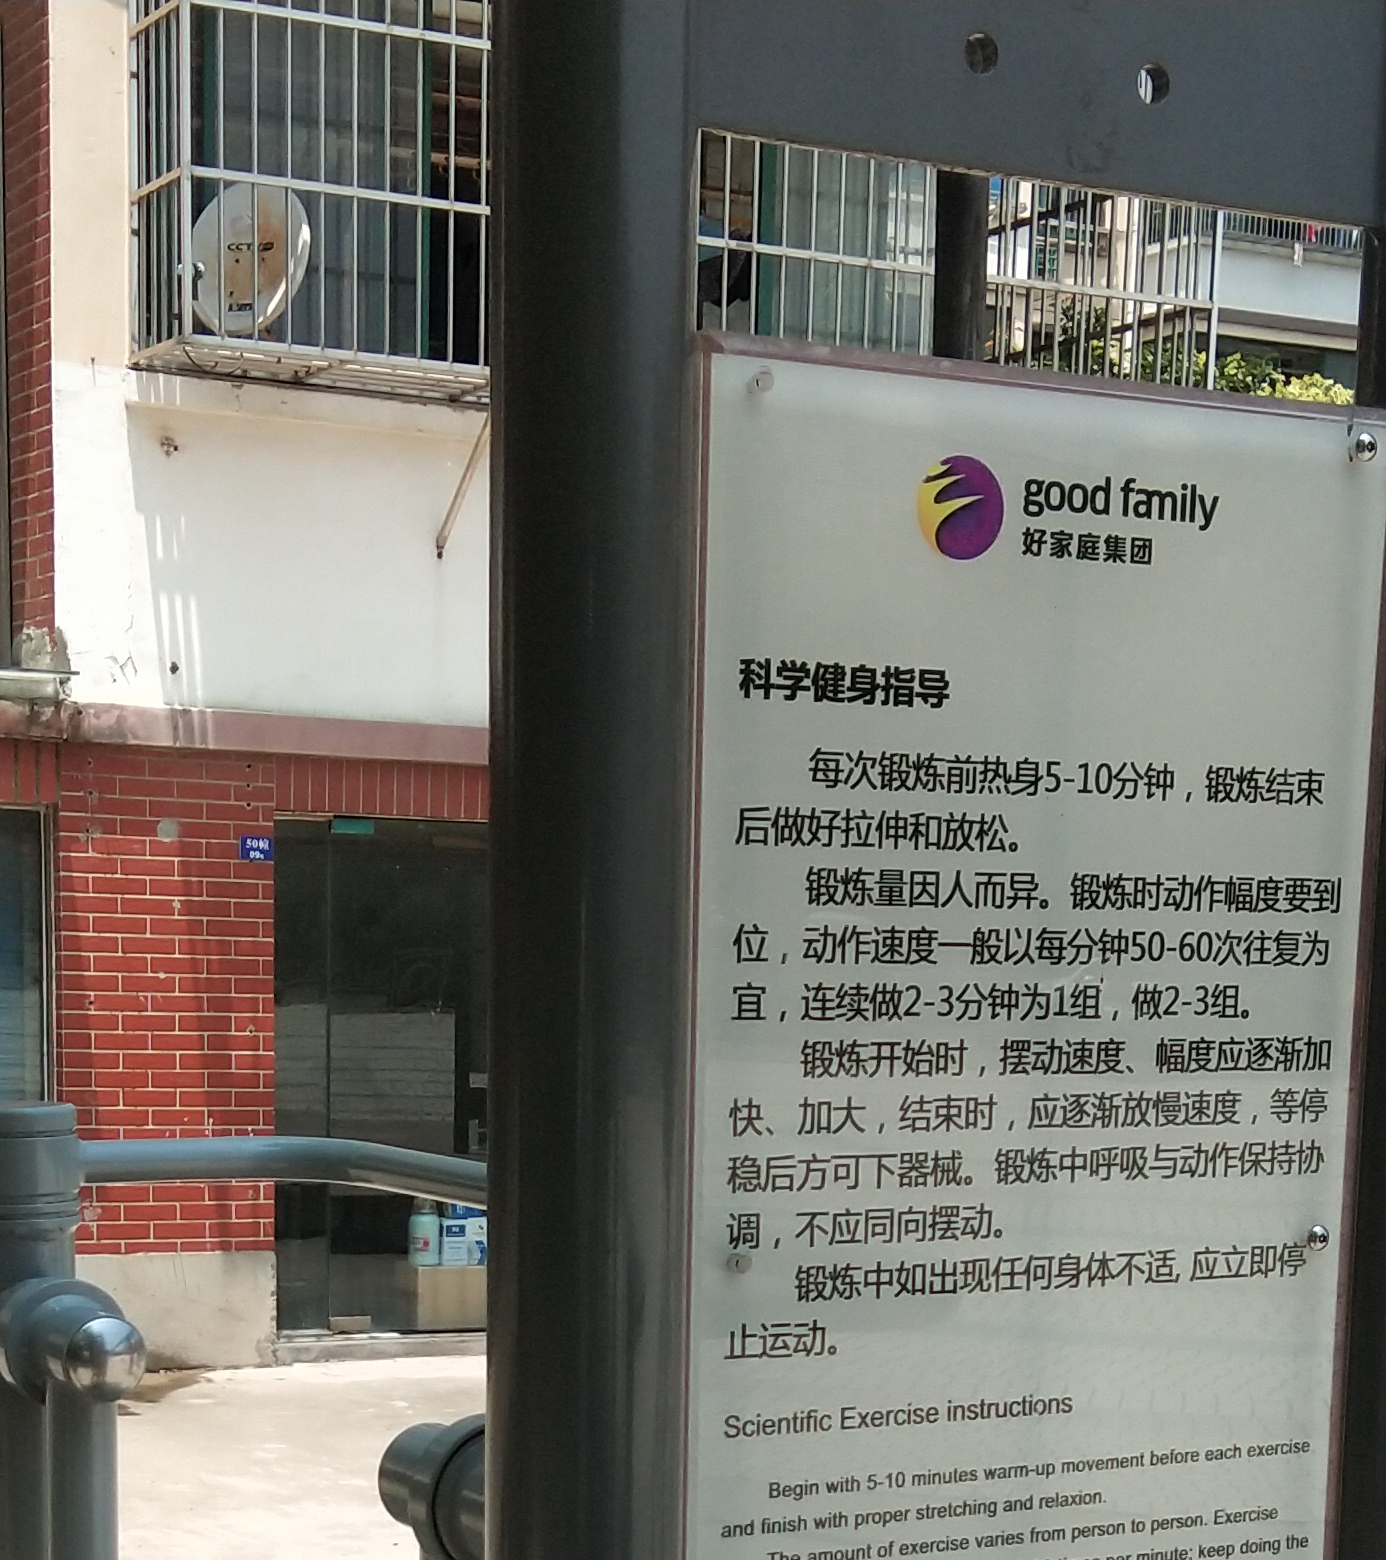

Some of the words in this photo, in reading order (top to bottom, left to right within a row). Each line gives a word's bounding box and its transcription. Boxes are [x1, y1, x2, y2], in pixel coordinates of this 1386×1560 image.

[1023, 476, 1111, 517] good
[1120, 478, 1220, 531] family
[1021, 526, 1154, 565] 好家庭集团
[739, 658, 949, 708] 科学健身指导
[735, 807, 1018, 852] 后做好拉伸和放松。
[805, 866, 1341, 913] 锻炼量因人而异。锻炼时动作幅度要到
[726, 1203, 1002, 1250] 调，不应同向摆动。
[724, 1320, 837, 1359] 止运动。
[724, 1409, 832, 1438] Scientific
[841, 1403, 939, 1430] Exercise
[947, 1394, 1073, 1421] instructions
[769, 1480, 819, 1501] Begin
[825, 1476, 860, 1493] with
[867, 1472, 905, 1490] 5-10
[912, 1468, 978, 1486] minutes
[984, 1463, 1055, 1480] warm-up
[1061, 1452, 1144, 1473] movement
[1150, 1449, 1199, 1466] before
[1205, 1444, 1241, 1461] each
[1247, 1439, 1310, 1457] exercise
[721, 1520, 754, 1538] and
[761, 1515, 807, 1534] finish
[813, 1512, 848, 1529] with
[855, 1509, 910, 1530] proper
[916, 1499, 997, 1520] stretching
[1003, 1495, 1033, 1512] and
[1039, 1492, 1106, 1509] relaxion.
[877, 1541, 894, 1557] of
[899, 1536, 969, 1555] exercise
[975, 1533, 1024, 1548] varies
[1030, 1527, 1065, 1543] from
[1071, 1523, 1125, 1543] person
[1131, 1519, 1145, 1533] to
[1151, 1515, 1207, 1535] person.
[1214, 1506, 1278, 1525] Exercise
[1198, 1545, 1235, 1559] keep
[1240, 1538, 1281, 1555] doing
[1286, 1535, 1308, 1550] the
